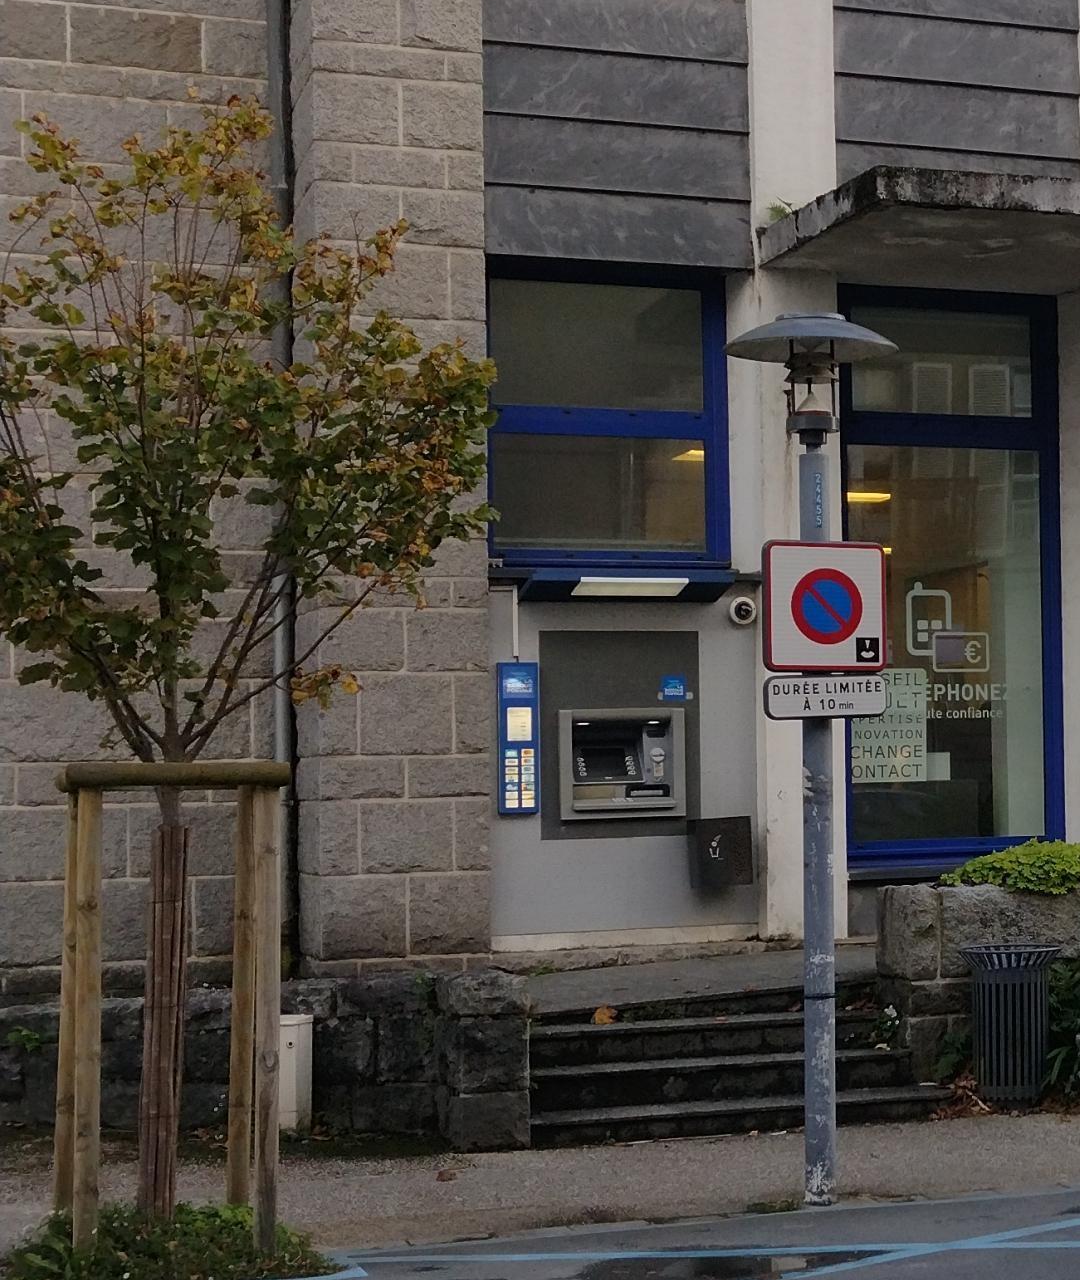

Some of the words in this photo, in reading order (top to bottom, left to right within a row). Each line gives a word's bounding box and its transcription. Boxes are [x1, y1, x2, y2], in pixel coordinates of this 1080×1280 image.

[772, 681, 820, 696] DURÉE
[825, 679, 882, 694] LIMITÉE
[803, 697, 812, 711] À
[819, 698, 836, 711] 10
[838, 700, 854, 710] min
[945, 706, 1003, 719] confiance
[854, 729, 923, 740] NOVATION
[851, 745, 923, 759] CHANGE
[851, 764, 922, 778] ONTACT
